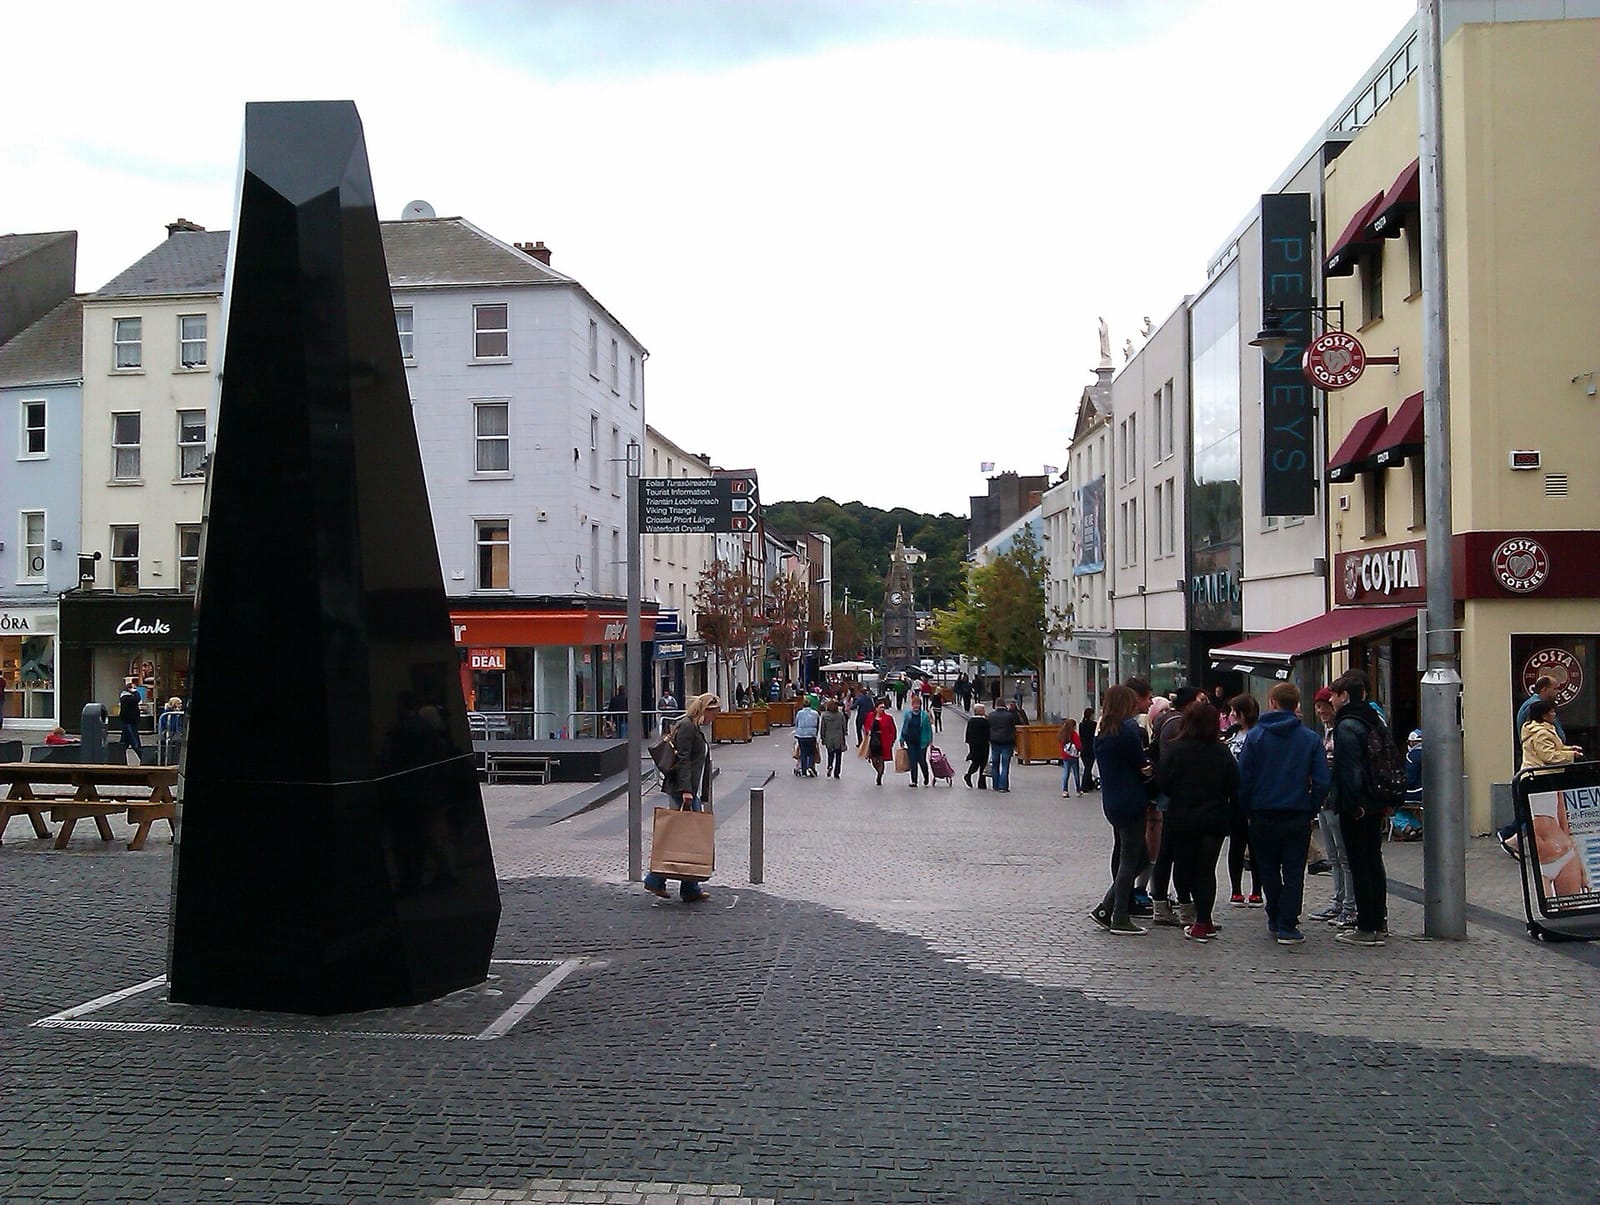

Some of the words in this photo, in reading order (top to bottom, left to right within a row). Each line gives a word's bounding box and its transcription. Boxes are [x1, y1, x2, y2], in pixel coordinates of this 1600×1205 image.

[1316, 335, 1356, 351] COSTA
[1313, 364, 1361, 385] COFFEE
[645, 488, 670, 496] Tourist
[671, 488, 711, 496] Information
[645, 506, 668, 516] Viking
[669, 506, 697, 516] Triangle
[645, 525, 680, 533] Waterford
[681, 525, 706, 533] Crystal
[1503, 541, 1537, 556] COSTA
[1361, 549, 1420, 596] COSTA
[1501, 571, 1544, 589] COFFEE
[116, 617, 171, 635] Clarks
[471, 655, 504, 668] DEAL
[1531, 650, 1573, 668] COSTA
